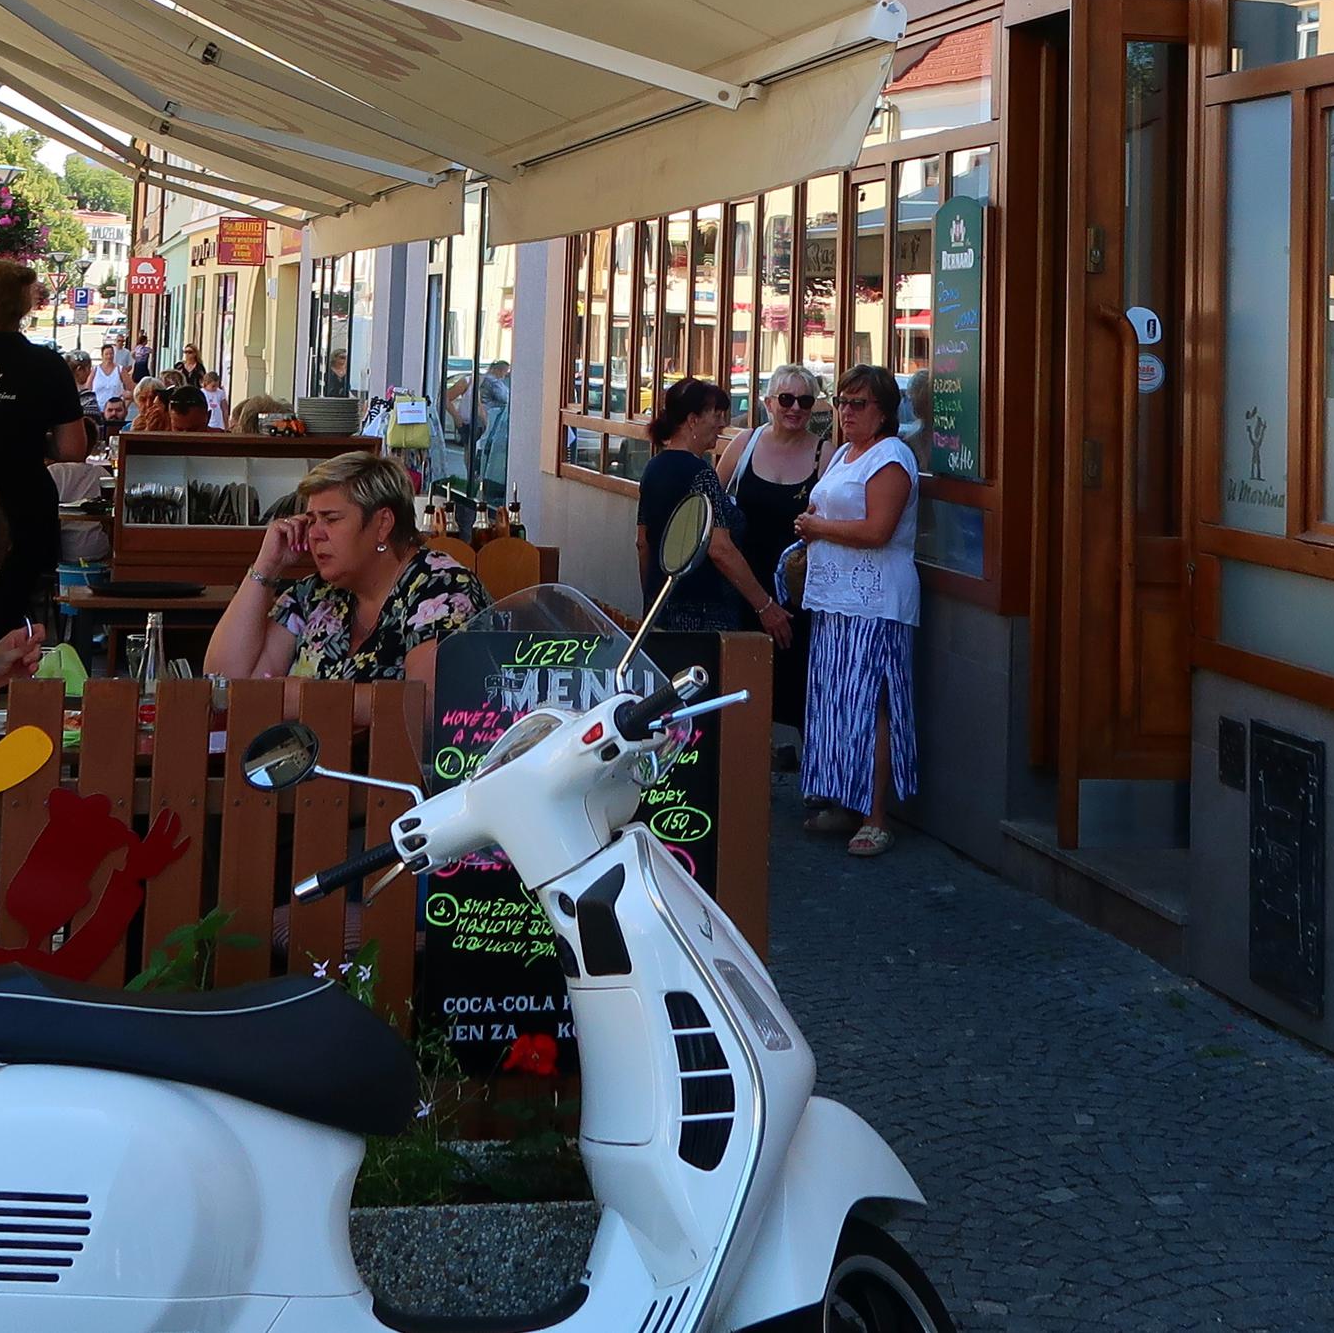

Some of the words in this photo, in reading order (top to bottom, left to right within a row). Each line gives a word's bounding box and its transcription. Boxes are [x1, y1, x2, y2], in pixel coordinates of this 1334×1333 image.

[91, 226, 124, 240] MUZEUM
[941, 248, 974, 271] BERNARD
[131, 275, 160, 285] BOTY
[76, 290, 86, 302] P
[1238, 479, 1285, 509] Martina
[443, 995, 556, 1014] COCA-COLA
[444, 1024, 484, 1042] JEN
[490, 1024, 518, 1040] ZA
